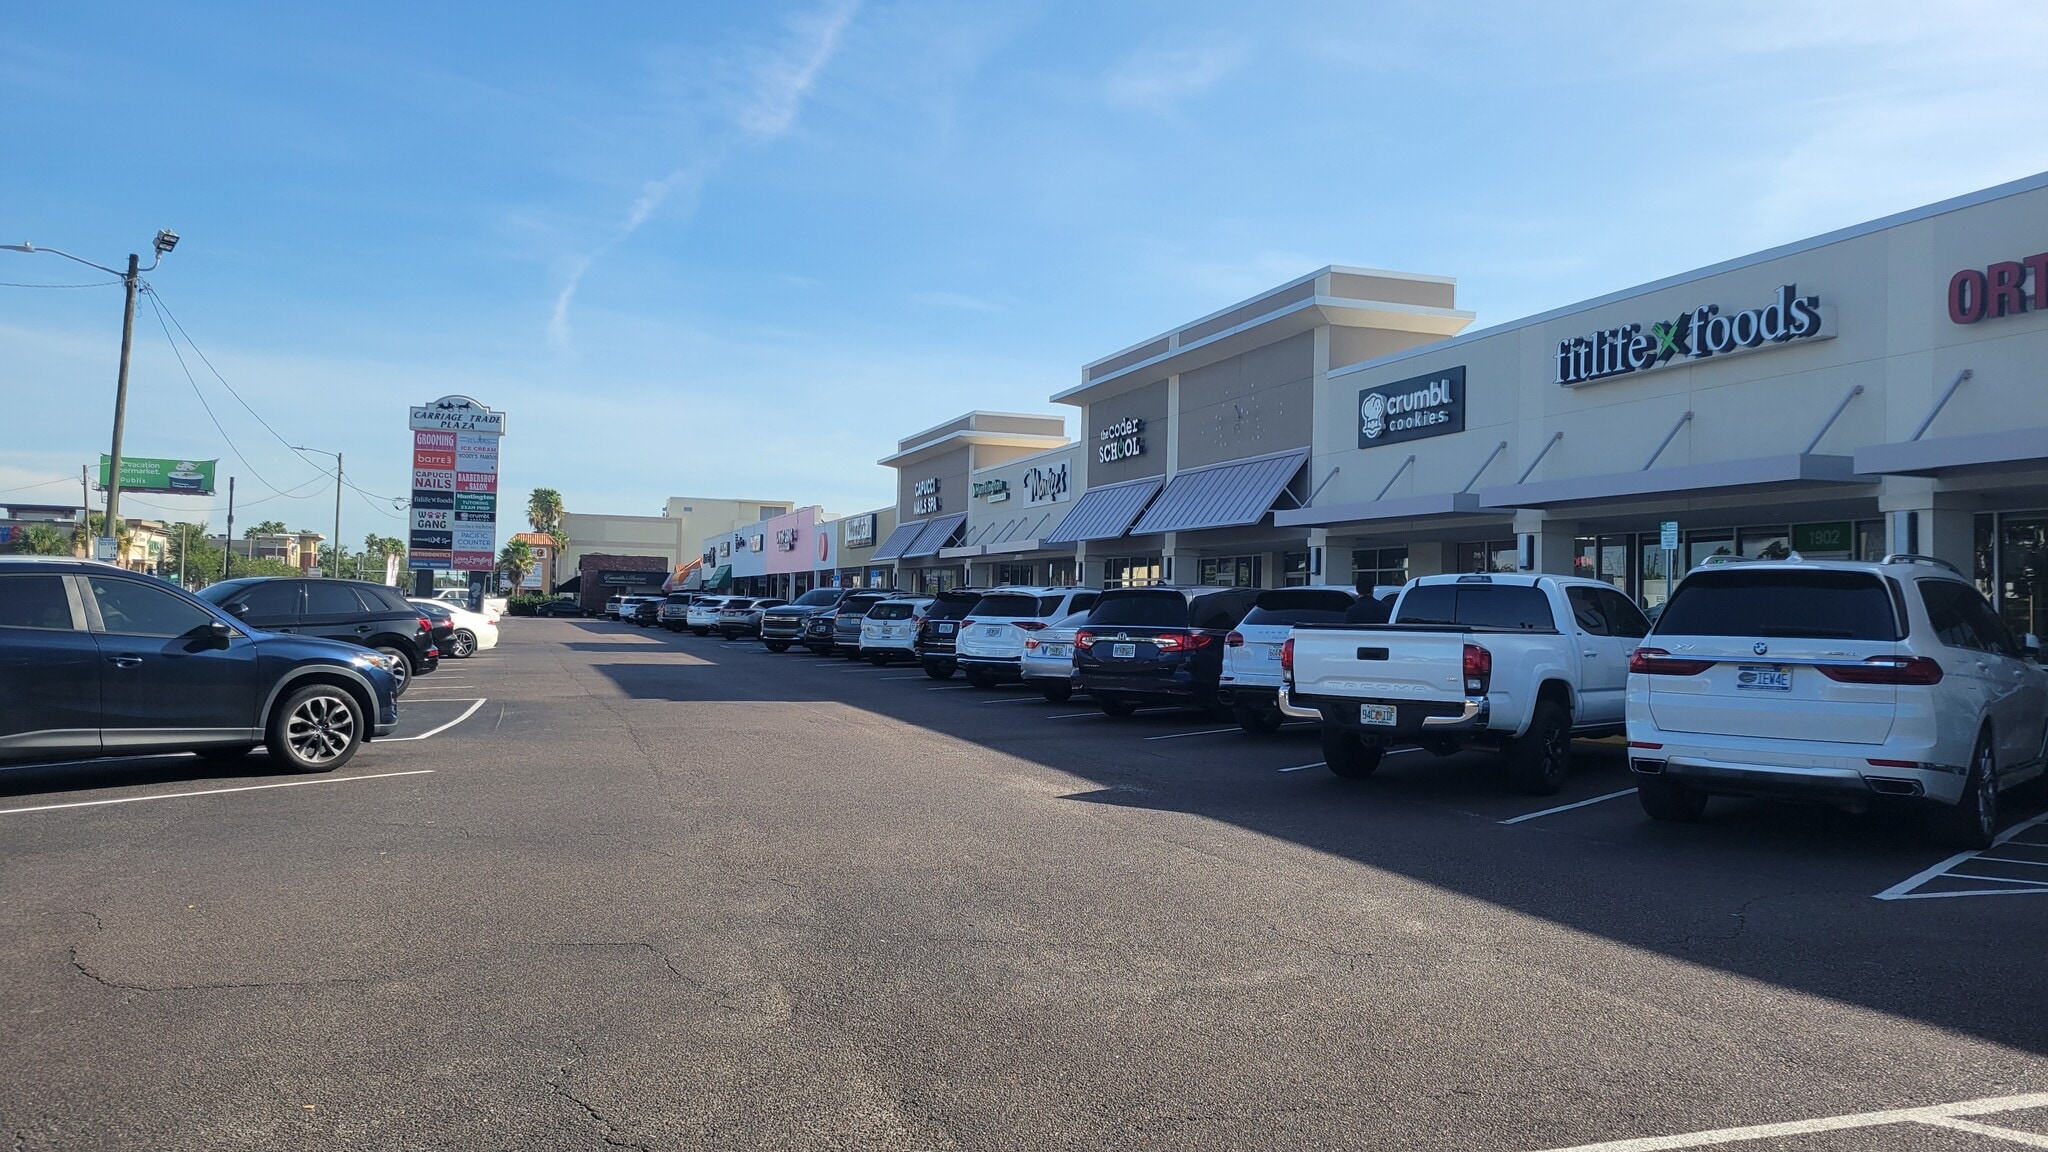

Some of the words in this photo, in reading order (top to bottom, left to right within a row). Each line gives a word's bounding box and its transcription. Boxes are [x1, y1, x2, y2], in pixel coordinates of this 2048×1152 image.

[1553, 324, 1649, 384] fitlife
[1688, 283, 1817, 356] foods
[1387, 379, 1450, 415] crumbl
[414, 411, 463, 422] CARRIAGE
[470, 414, 502, 424] TRADE
[1389, 410, 1447, 432] cookies
[440, 421, 475, 430] PLAZA
[1100, 429, 1109, 441] the
[1109, 417, 1139, 439] coder
[417, 433, 454, 447] GROOMING
[120, 476, 146, 484] Publix
[416, 471, 452, 479] CAPUCCI
[457, 473, 496, 483] BARBERSHOP
[415, 478, 452, 489] NAILS
[469, 482, 488, 491] SALON
[436, 496, 453, 504] foods
[457, 493, 495, 501] Huntington
[418, 519, 447, 529] GANG
[1809, 529, 1840, 546] 1902
[1328, 680, 1428, 693] TACOMA
